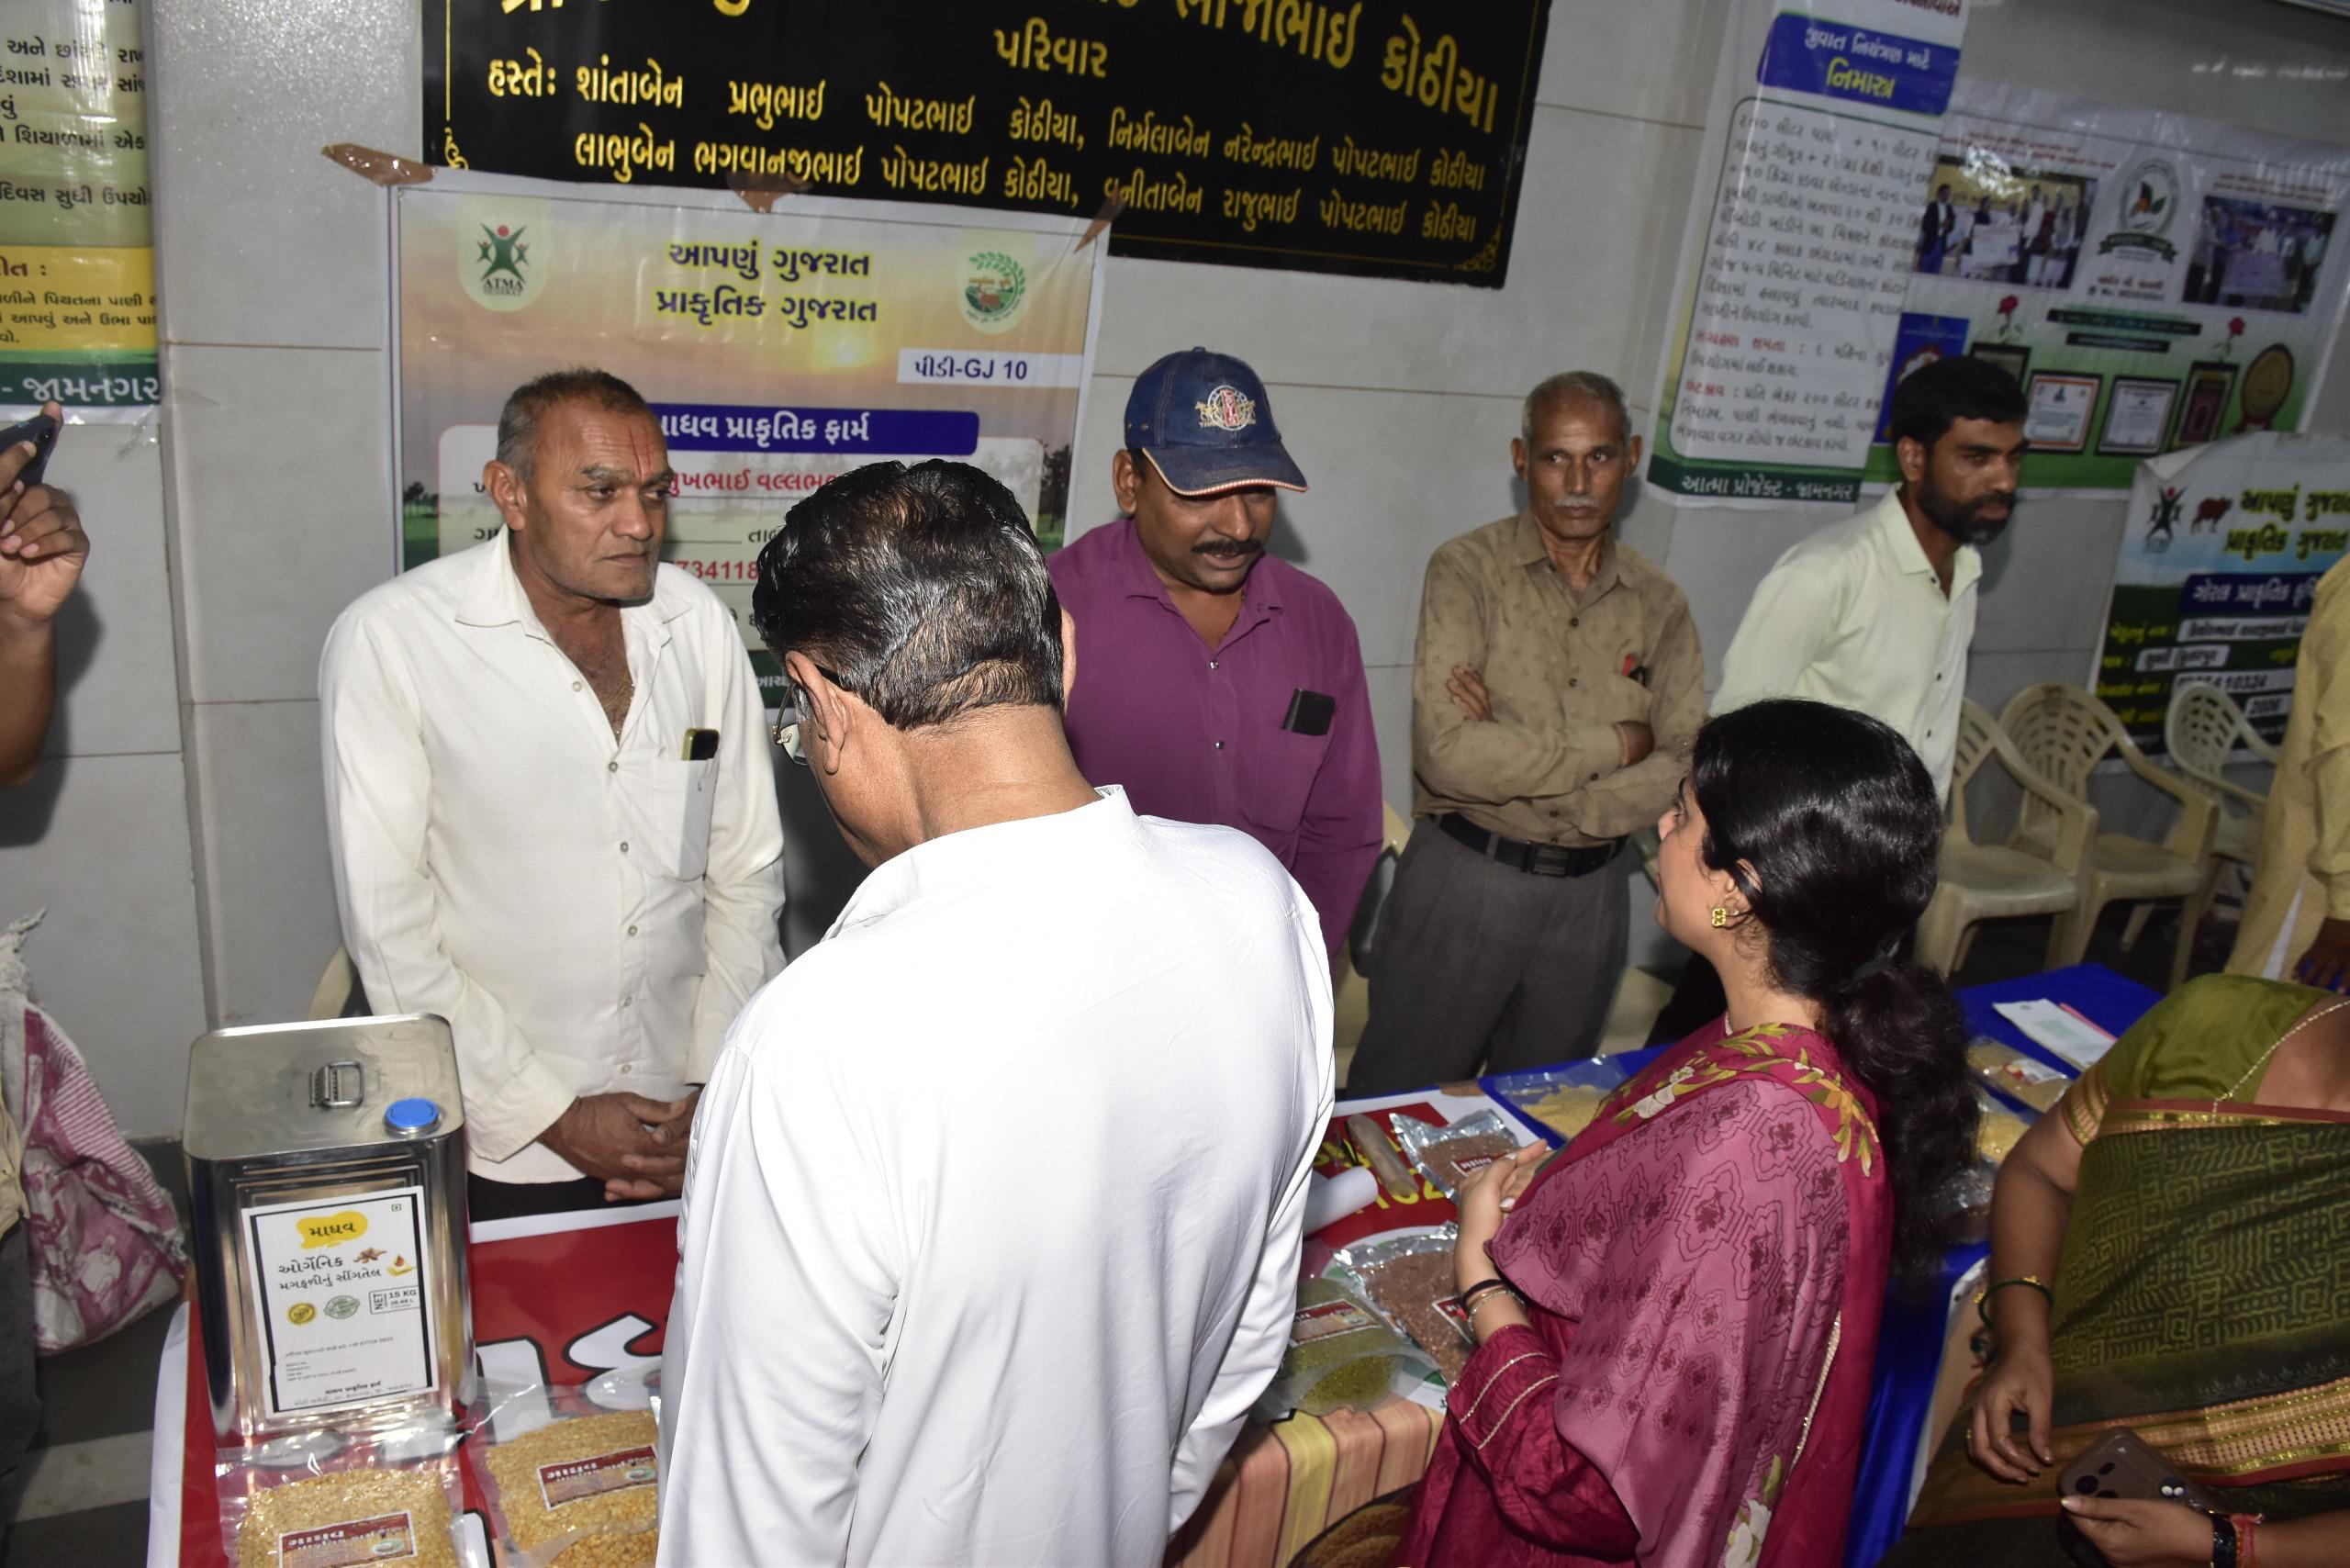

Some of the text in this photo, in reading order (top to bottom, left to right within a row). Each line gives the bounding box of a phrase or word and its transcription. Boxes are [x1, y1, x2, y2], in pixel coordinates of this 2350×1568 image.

[7, 36, 45, 56] અને
[994, 17, 1107, 78] પરિવાર
[1381, 15, 1498, 133] કોઠીયા
[576, 52, 683, 109] શાંતાબેન
[728, 79, 825, 130] પ્રભુભાઈ
[866, 81, 975, 134] પોપટભાઈ
[1108, 106, 1210, 158] નિર્મલાબેન
[1224, 122, 1319, 171] નરેન્દ્રભાઈ
[1333, 136, 1420, 183] પોપટભાઈ
[1430, 148, 1484, 190] કોઠીયા
[575, 122, 676, 184] લાભુબેન
[694, 141, 864, 186] ભગવાનજીભાઈ
[880, 145, 989, 196] પોપટભાઈ
[1223, 189, 1300, 231] રાજુભાઈ
[1320, 189, 1406, 234] પોપટભાઈ
[1423, 201, 1476, 241] કોઠીયા
[55, 185, 93, 209] સુધી
[669, 241, 870, 280] આપણું ગુજરાત
[44, 292, 101, 306] પિયતના
[108, 294, 142, 307] પાણી
[656, 286, 878, 329] પ્રાકૃતિક ગુજરાત
[11, 311, 56, 329] આપવું
[62, 312, 92, 325] અને
[1004, 360, 1027, 379] 10
[23, 376, 160, 402] જામનગર
[661, 410, 871, 447] ાધવ પ્રાકૃતિક ફાર્મ
[670, 469, 751, 497] ુખભાઈ
[308, 1222, 356, 1237] માધવ
[373, 1294, 384, 1310] NET
